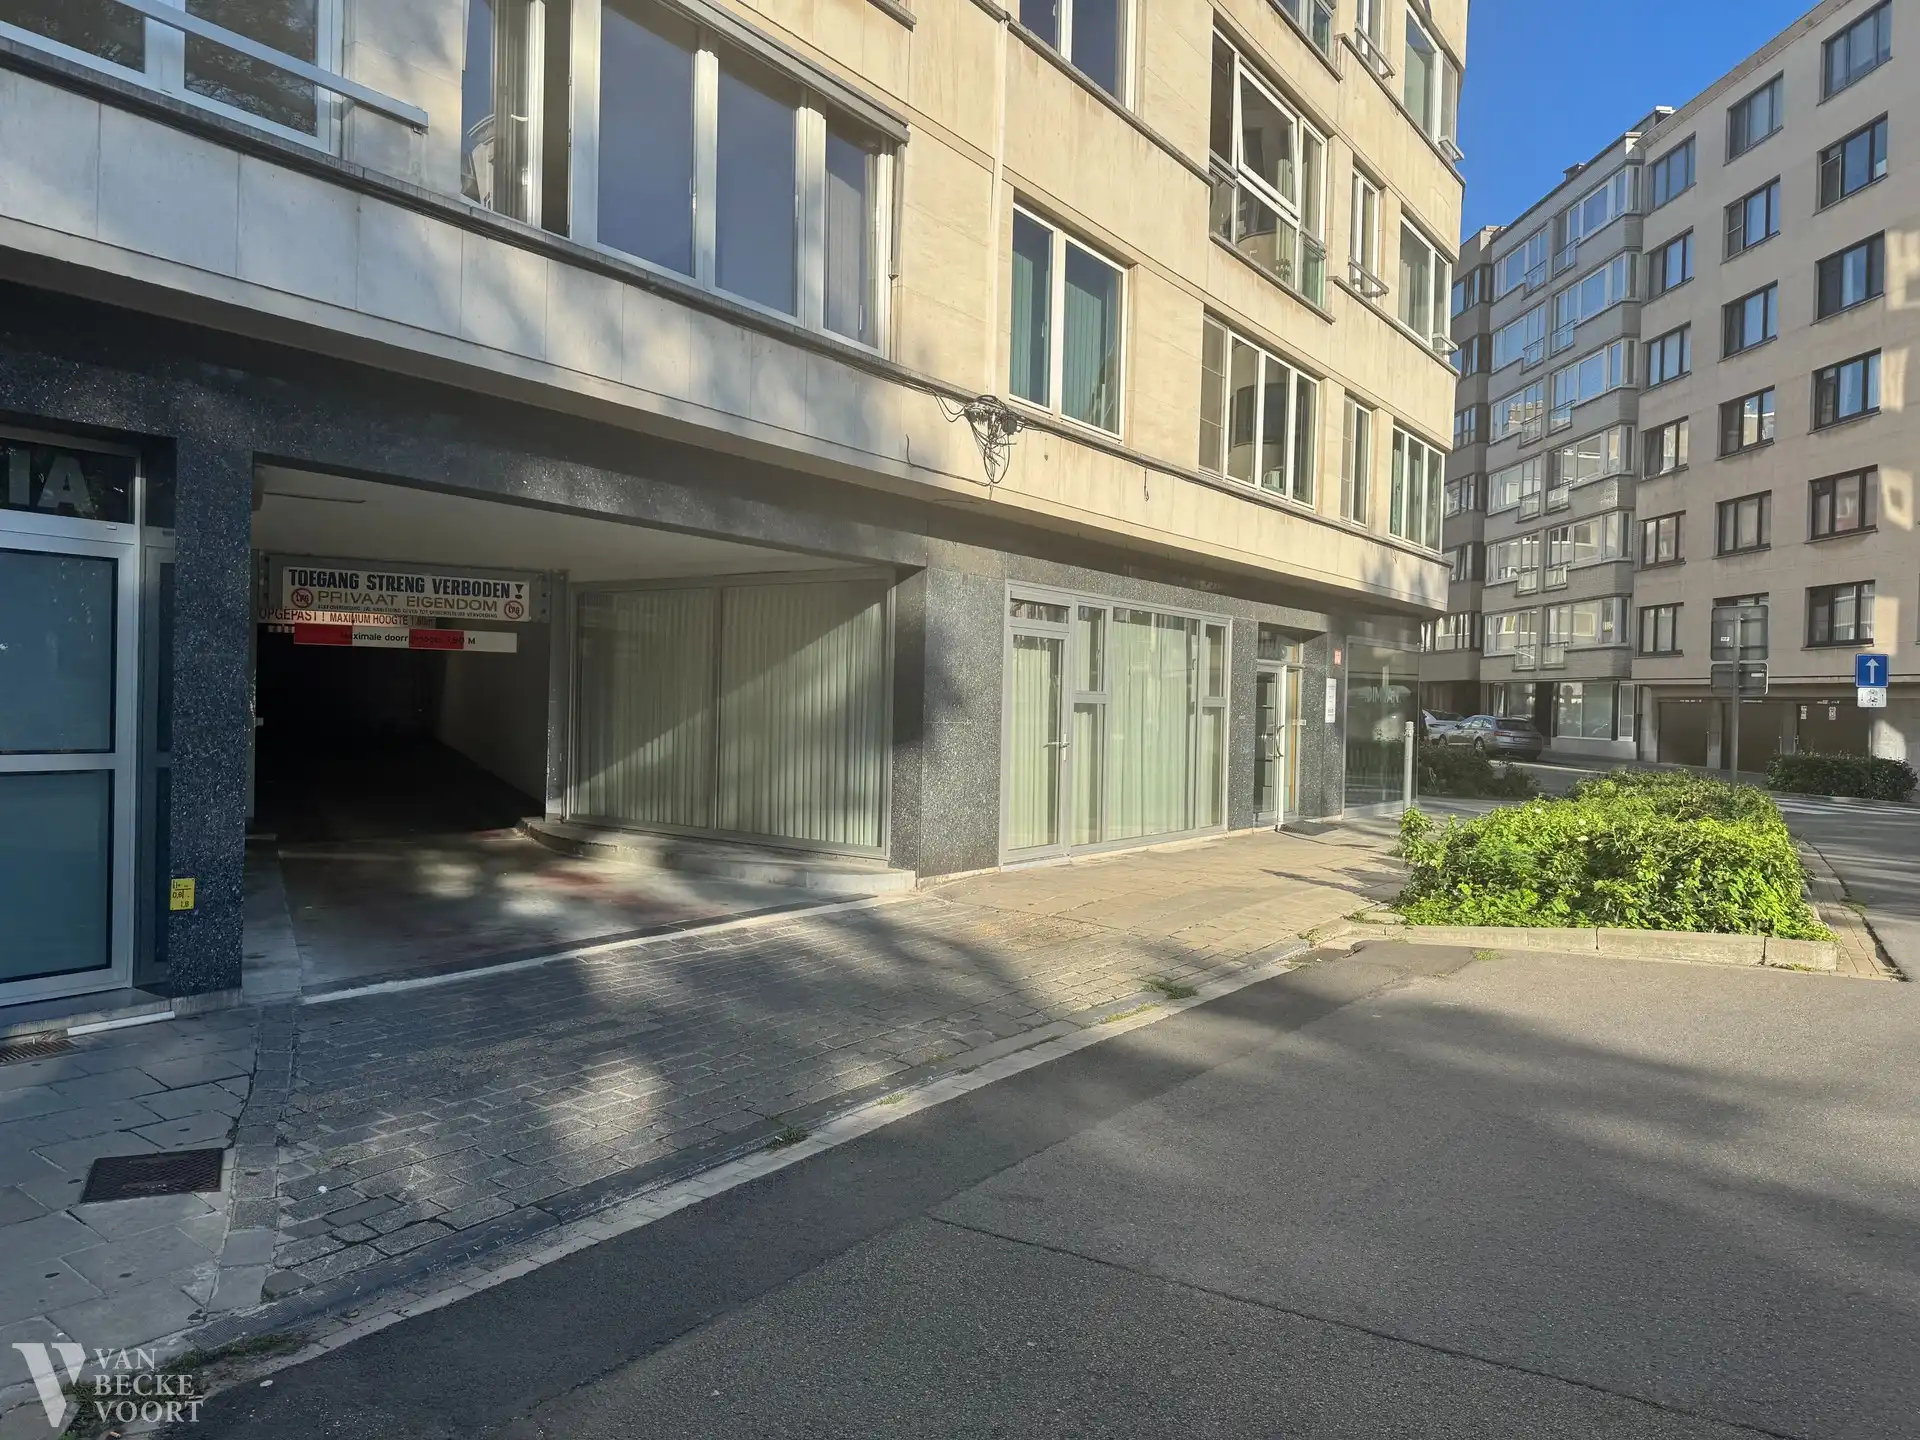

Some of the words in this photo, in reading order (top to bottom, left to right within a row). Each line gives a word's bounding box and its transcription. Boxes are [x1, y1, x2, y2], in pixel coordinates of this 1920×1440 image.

[289, 569, 359, 591] TOEGANG
[366, 574, 425, 594] STRENG
[317, 590, 397, 606] PRIVAAT
[406, 596, 498, 611] EIGENDOM
[329, 612, 371, 625] MAXIMUM
[372, 614, 408, 626] HOOGTE
[467, 637, 476, 645] M
